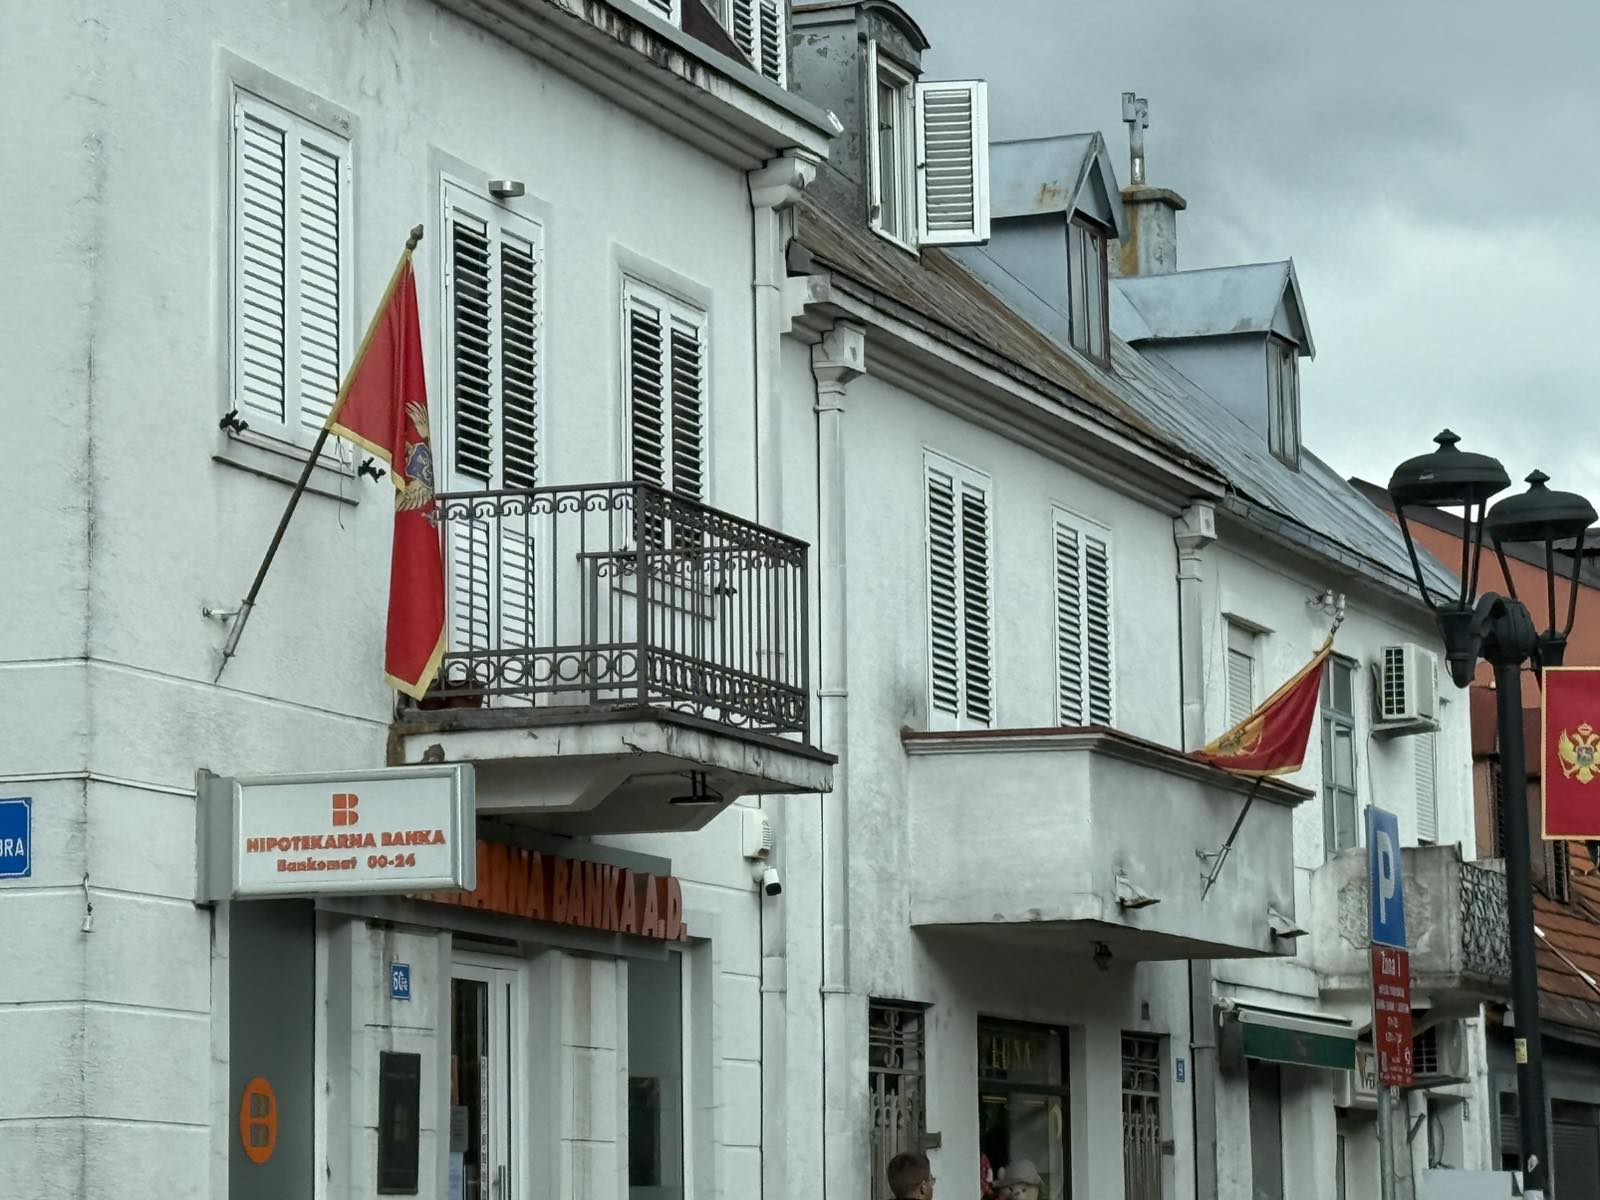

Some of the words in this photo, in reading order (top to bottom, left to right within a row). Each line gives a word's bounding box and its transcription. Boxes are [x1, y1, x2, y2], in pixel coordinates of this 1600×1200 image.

[246, 832, 377, 853] HIPOTEKARNA
[381, 829, 446, 847] BANKA
[277, 856, 358, 873] Bankomat
[552, 854, 637, 934] BANKA
[641, 873, 688, 942] A.D.
[1376, 829, 1395, 925] P
